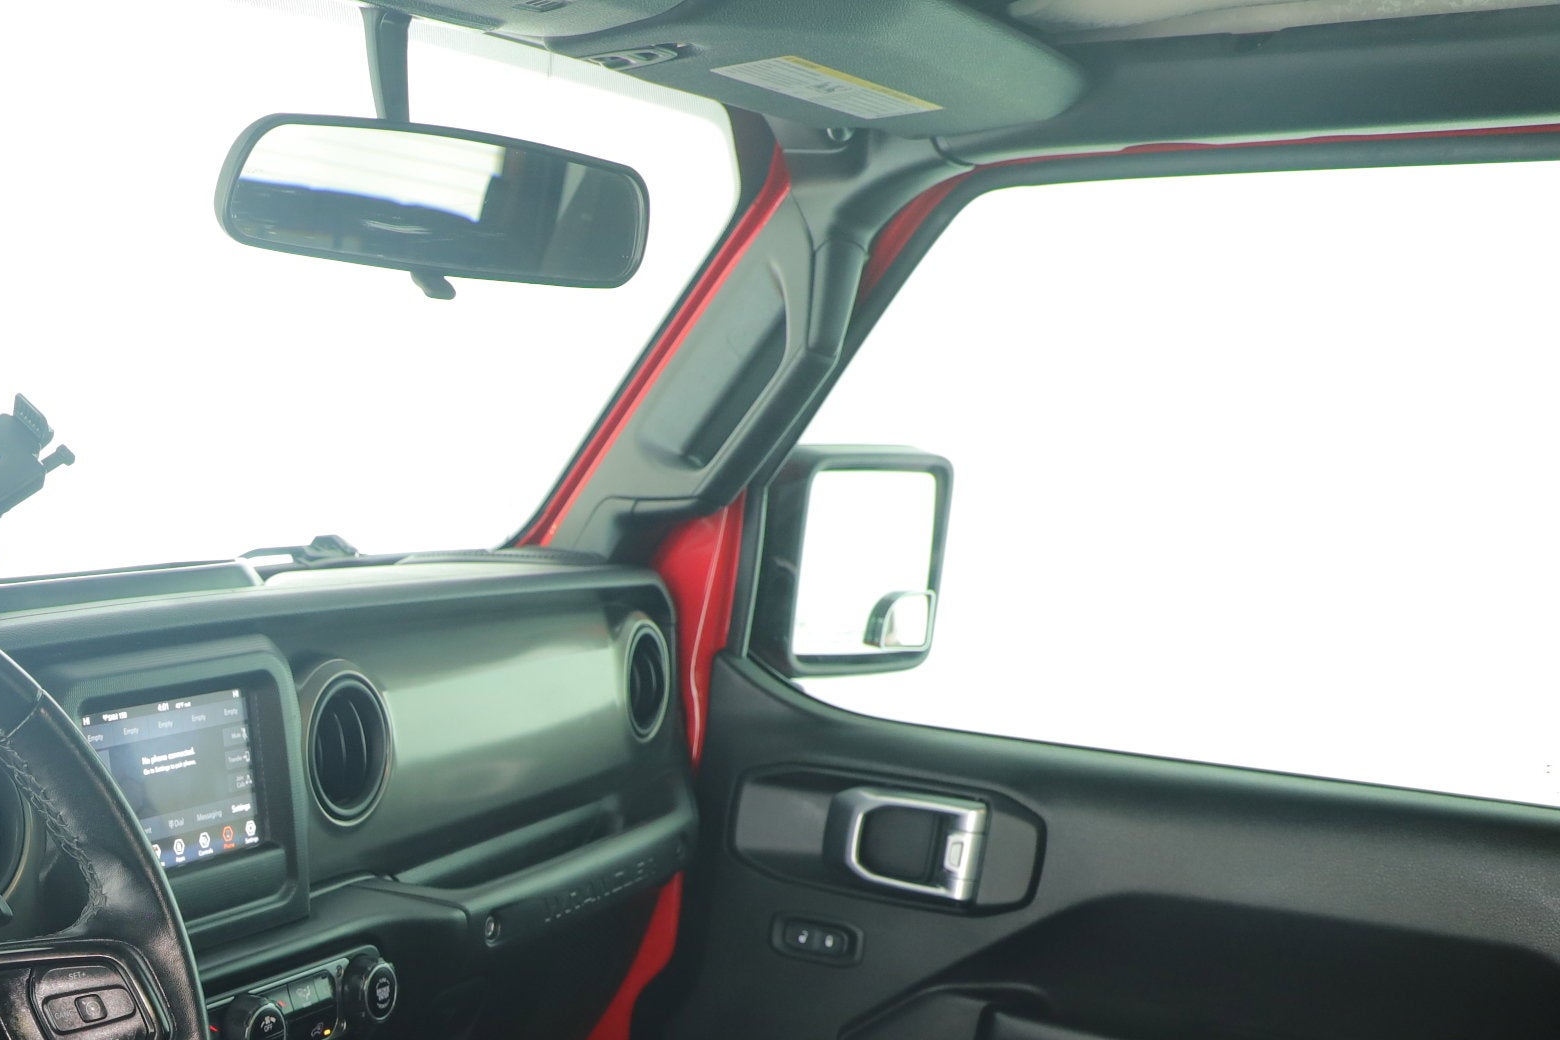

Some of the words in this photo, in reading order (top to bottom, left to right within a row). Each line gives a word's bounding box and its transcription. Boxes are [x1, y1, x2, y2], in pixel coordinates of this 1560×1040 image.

[224, 708, 238, 717] Empty
[192, 714, 206, 722] Empty
[158, 721, 174, 729] Empty
[124, 728, 139, 736] Empty
[88, 734, 104, 742] Empty
[232, 803, 251, 814] Settings
[196, 810, 222, 822] Messaging
[264, 1022, 273, 1032] OFF
